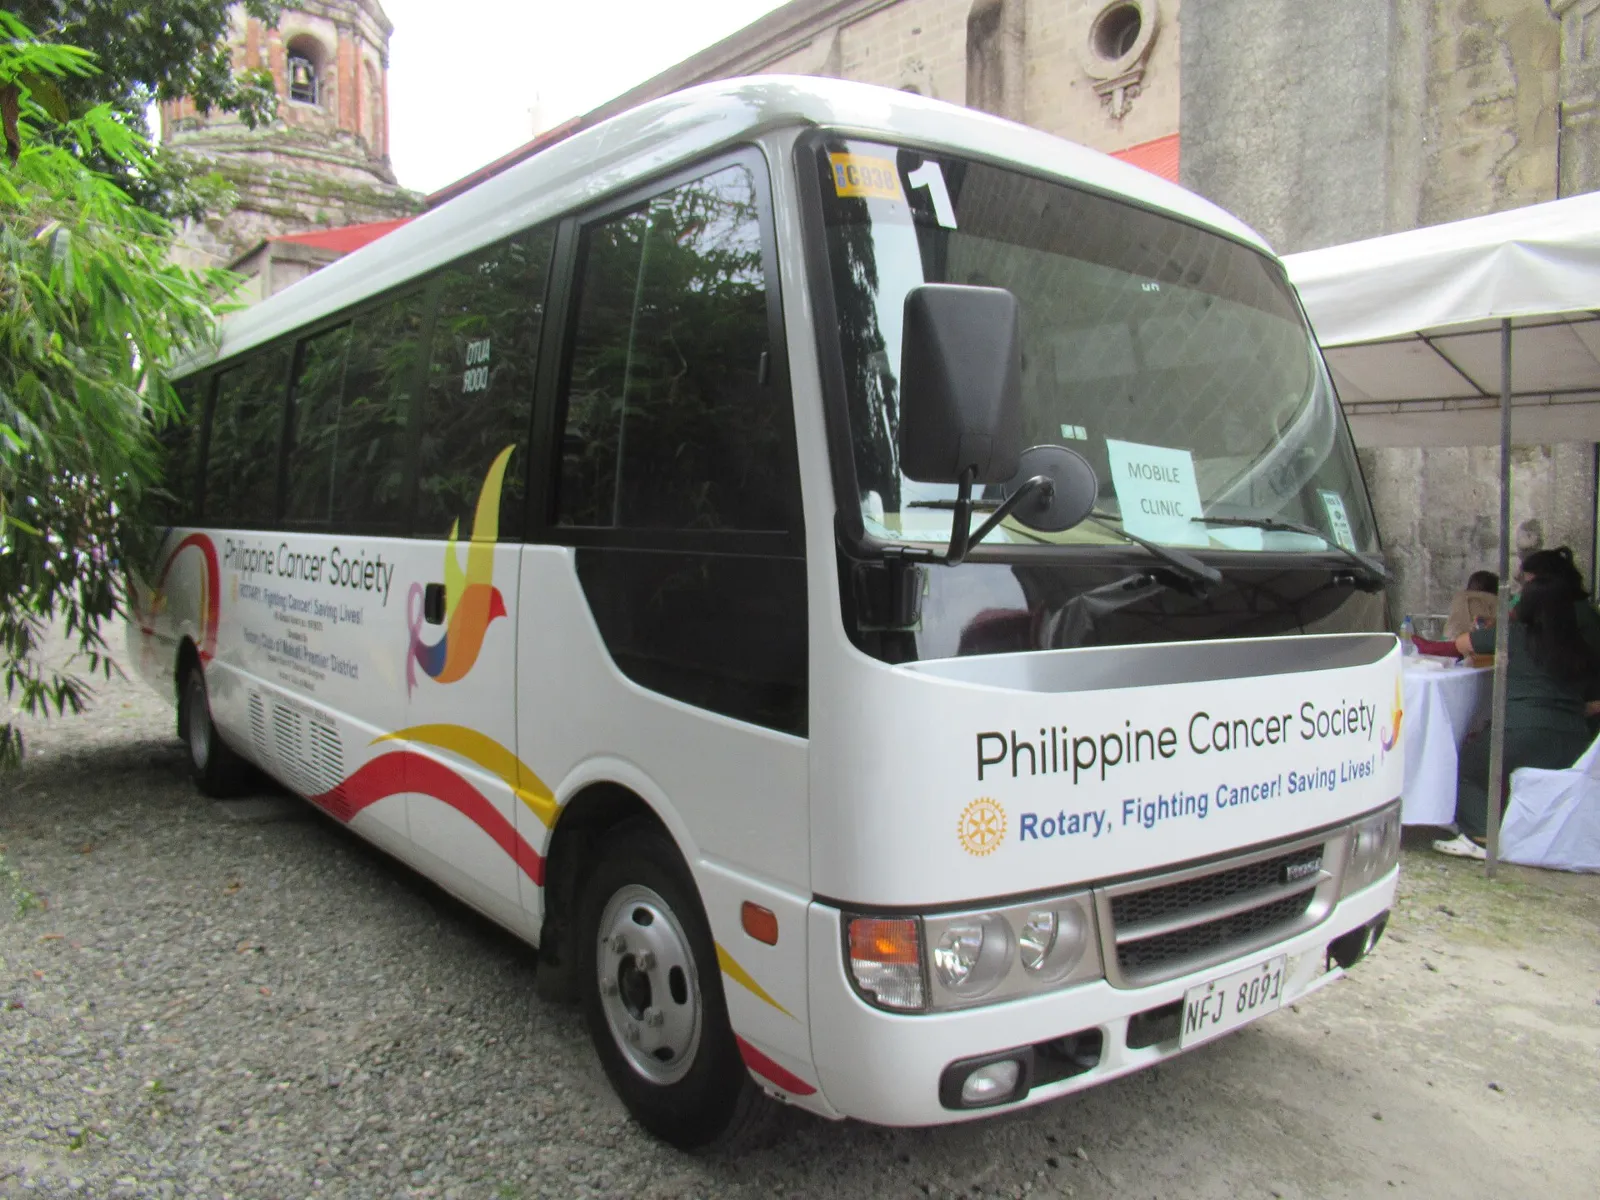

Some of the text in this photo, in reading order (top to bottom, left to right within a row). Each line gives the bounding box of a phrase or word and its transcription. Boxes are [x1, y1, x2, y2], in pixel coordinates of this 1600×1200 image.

[907, 160, 957, 230] 1
[1127, 461, 1181, 484] MOBILE
[1140, 497, 1184, 518] CLINIC
[224, 538, 394, 607] Philippine Cancer Society
[314, 600, 338, 624] Saving
[331, 654, 358, 679] District
[976, 698, 1377, 786] Philippine Cancer Society
[1019, 753, 1375, 842] Rotary, Fighting Cancer! Saving Lives!
[1184, 968, 1281, 1035] NFJ 8091
